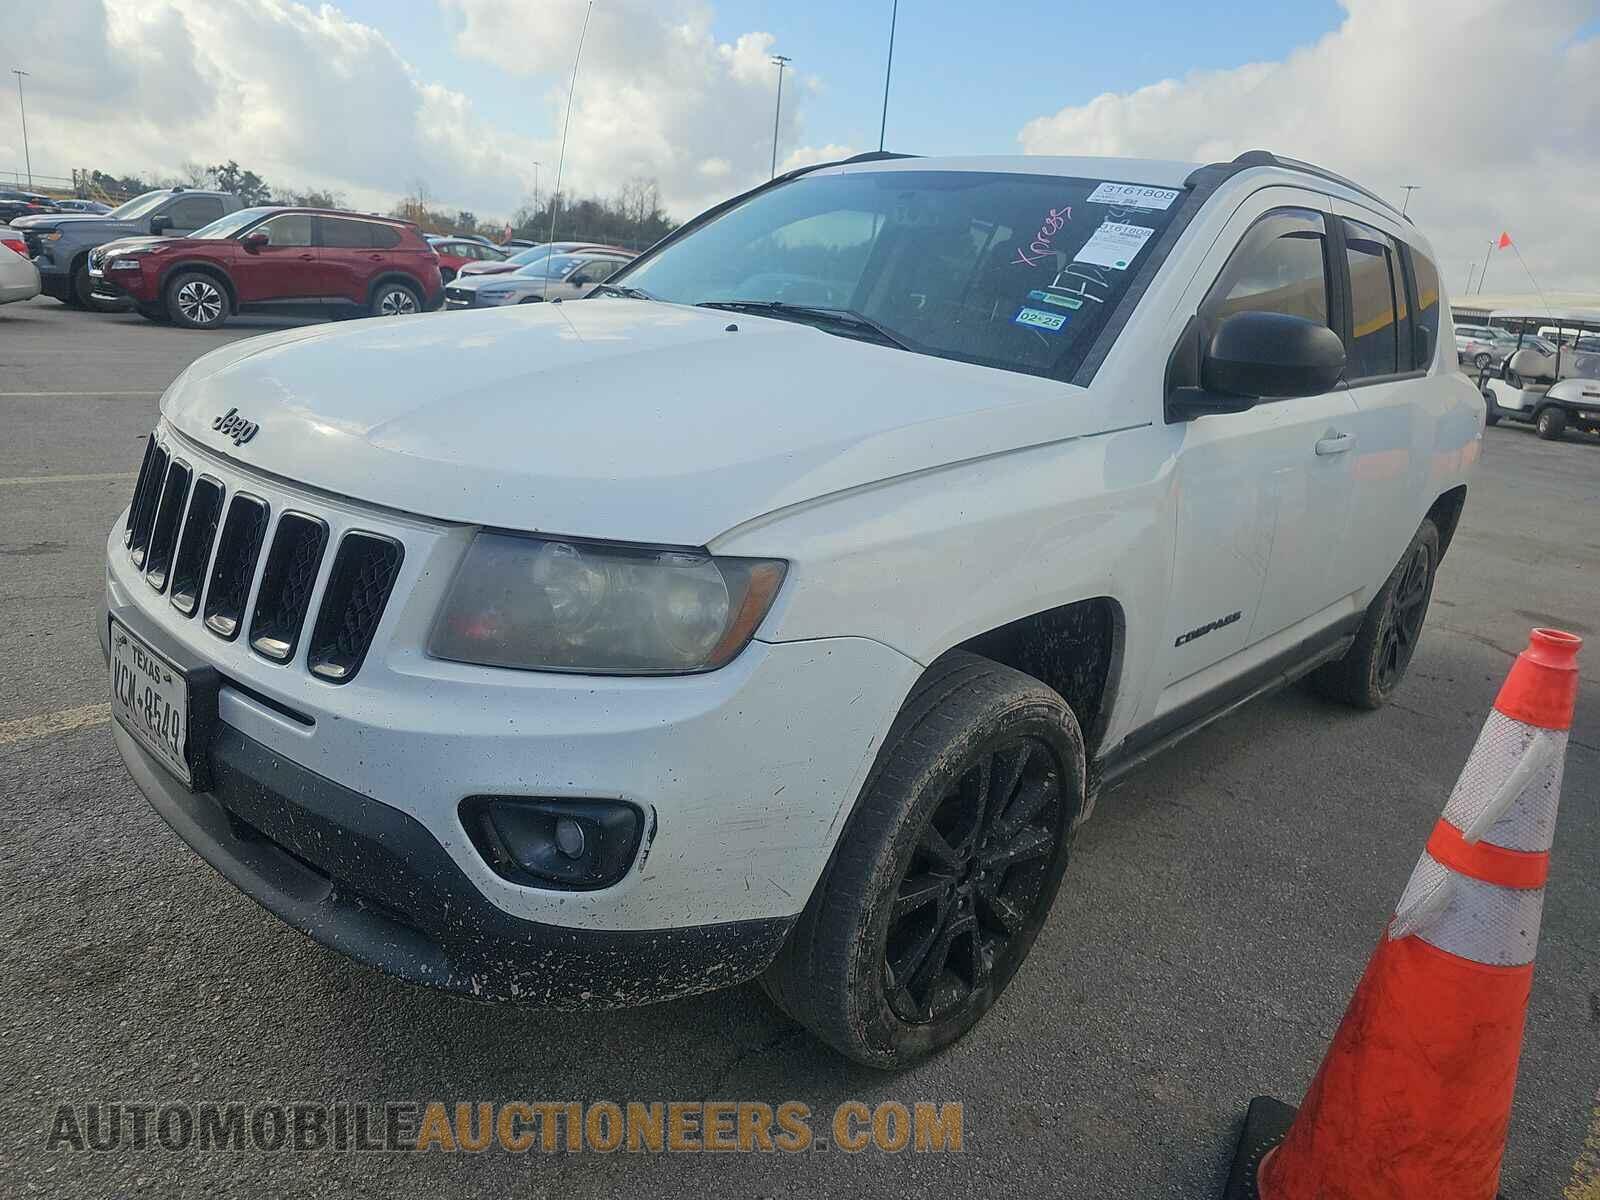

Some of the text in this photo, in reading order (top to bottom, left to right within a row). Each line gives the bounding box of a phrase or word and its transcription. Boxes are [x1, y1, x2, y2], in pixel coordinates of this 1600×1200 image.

[1103, 184, 1176, 200] 3161808
[212, 407, 260, 447] Jeep
[1174, 610, 1242, 648] COMPASS
[131, 644, 161, 685] TEXAS
